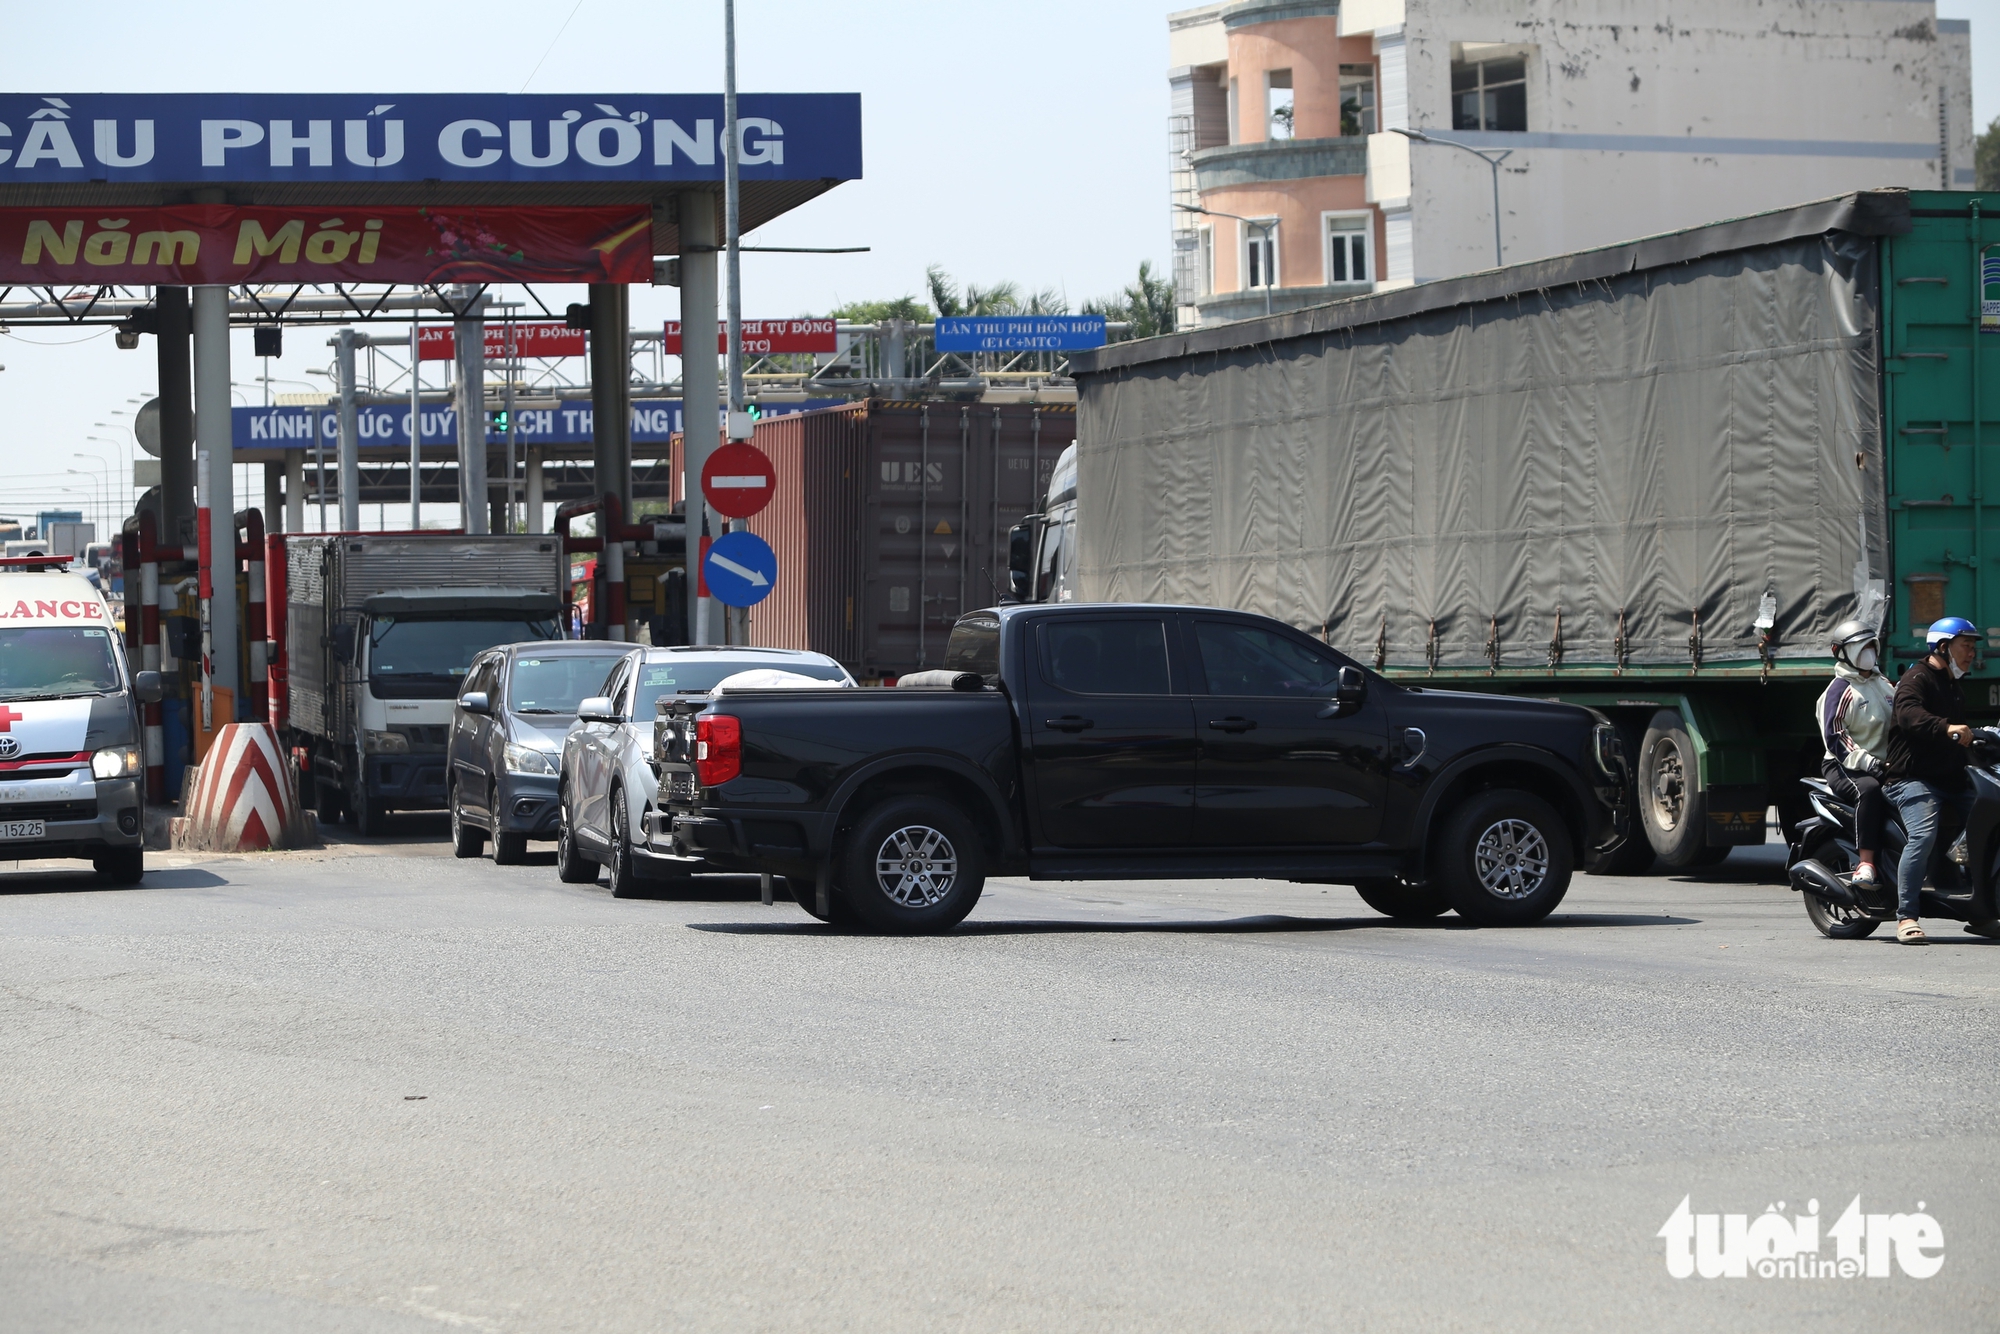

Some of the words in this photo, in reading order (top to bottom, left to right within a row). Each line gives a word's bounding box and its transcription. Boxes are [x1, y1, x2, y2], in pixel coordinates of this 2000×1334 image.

[0, 97, 155, 168] ẦU
[201, 104, 405, 167] PHÚ
[438, 103, 784, 167] CƯỜNG
[21, 217, 200, 266] Năm
[232, 217, 383, 265] Mới
[540, 326, 581, 340] ĐỘNG
[767, 321, 788, 337] TỰ
[792, 319, 834, 336] ĐỘNG
[941, 320, 971, 335] LÀN
[974, 322, 1005, 334] THU
[1008, 320, 1033, 334] PHÍ
[1072, 320, 1102, 334] HỢP
[741, 340, 771, 353] ETC)
[250, 409, 313, 439] KÍNH
[322, 408, 393, 438] CÚC
[881, 462, 943, 482] UES
[1008, 458, 1029, 469] UETU
